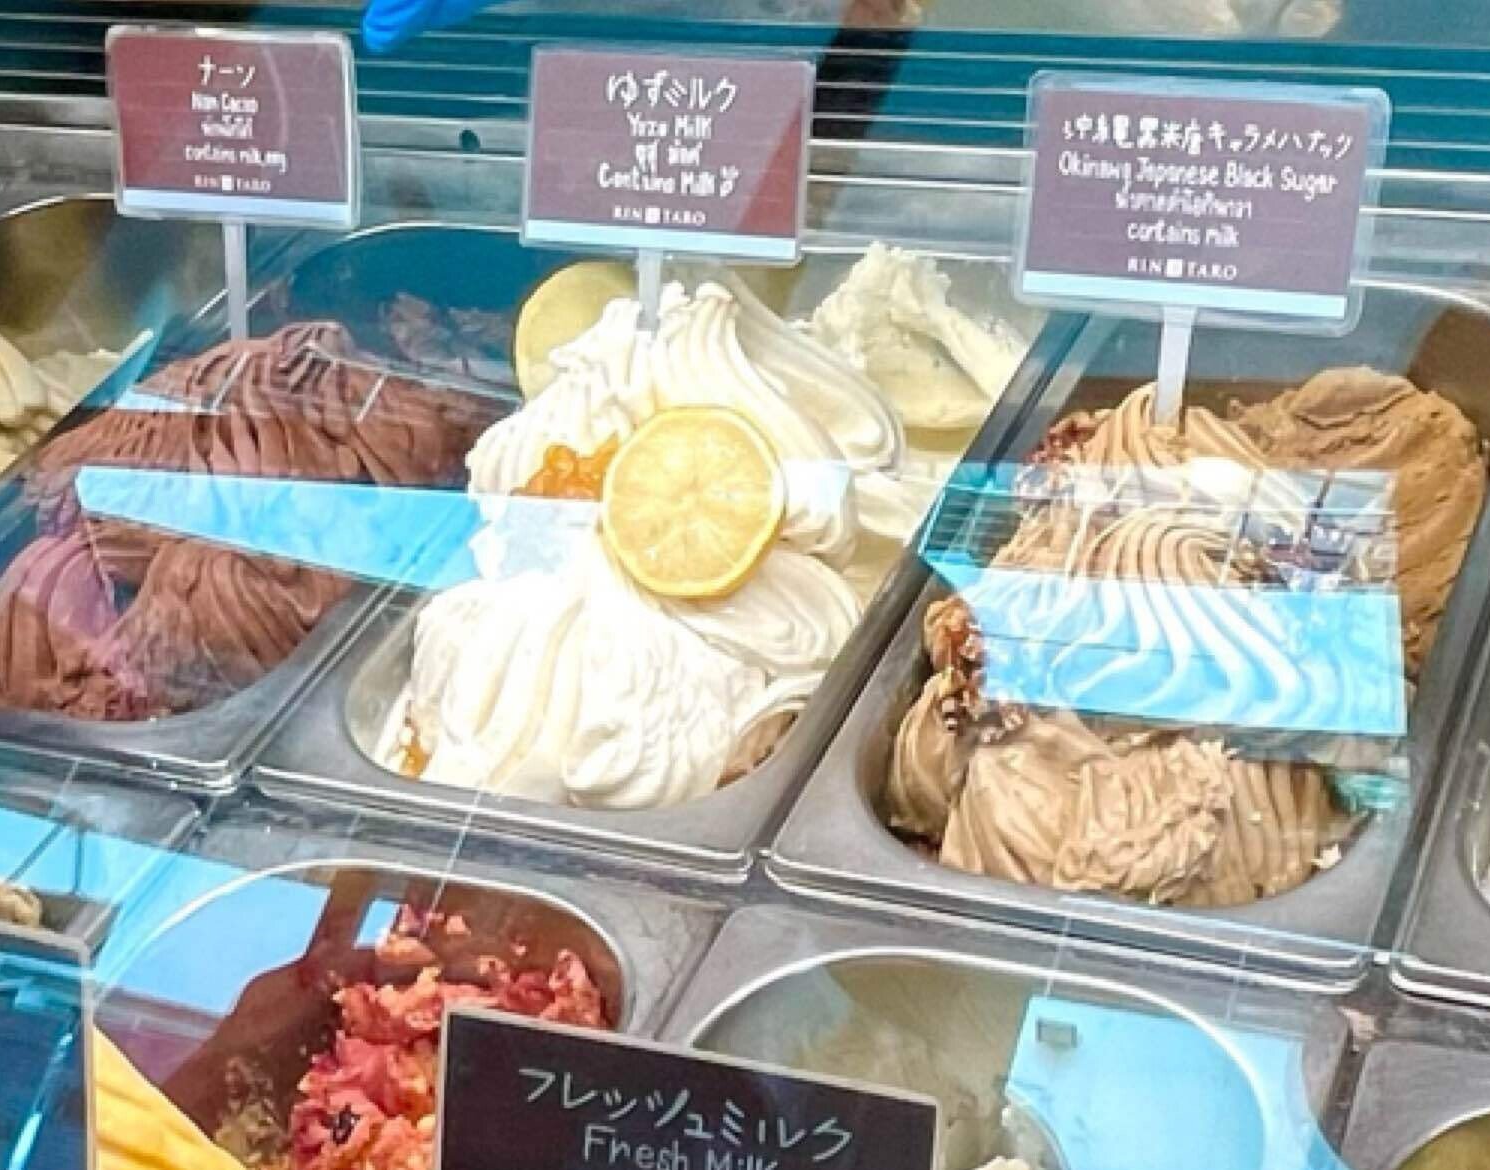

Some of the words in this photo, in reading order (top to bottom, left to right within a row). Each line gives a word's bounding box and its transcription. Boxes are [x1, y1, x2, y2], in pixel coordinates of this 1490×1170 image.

[606, 70, 737, 112] ゆずミルク
[1137, 156, 1219, 189] Japanese
[1224, 160, 1273, 189] Black
[1280, 165, 1338, 201] Sugar
[1127, 220, 1200, 246] contains
[1127, 257, 1162, 274] RIN
[1188, 260, 1237, 281] TARO
[518, 1067, 854, 1162] フレッシュミルク
